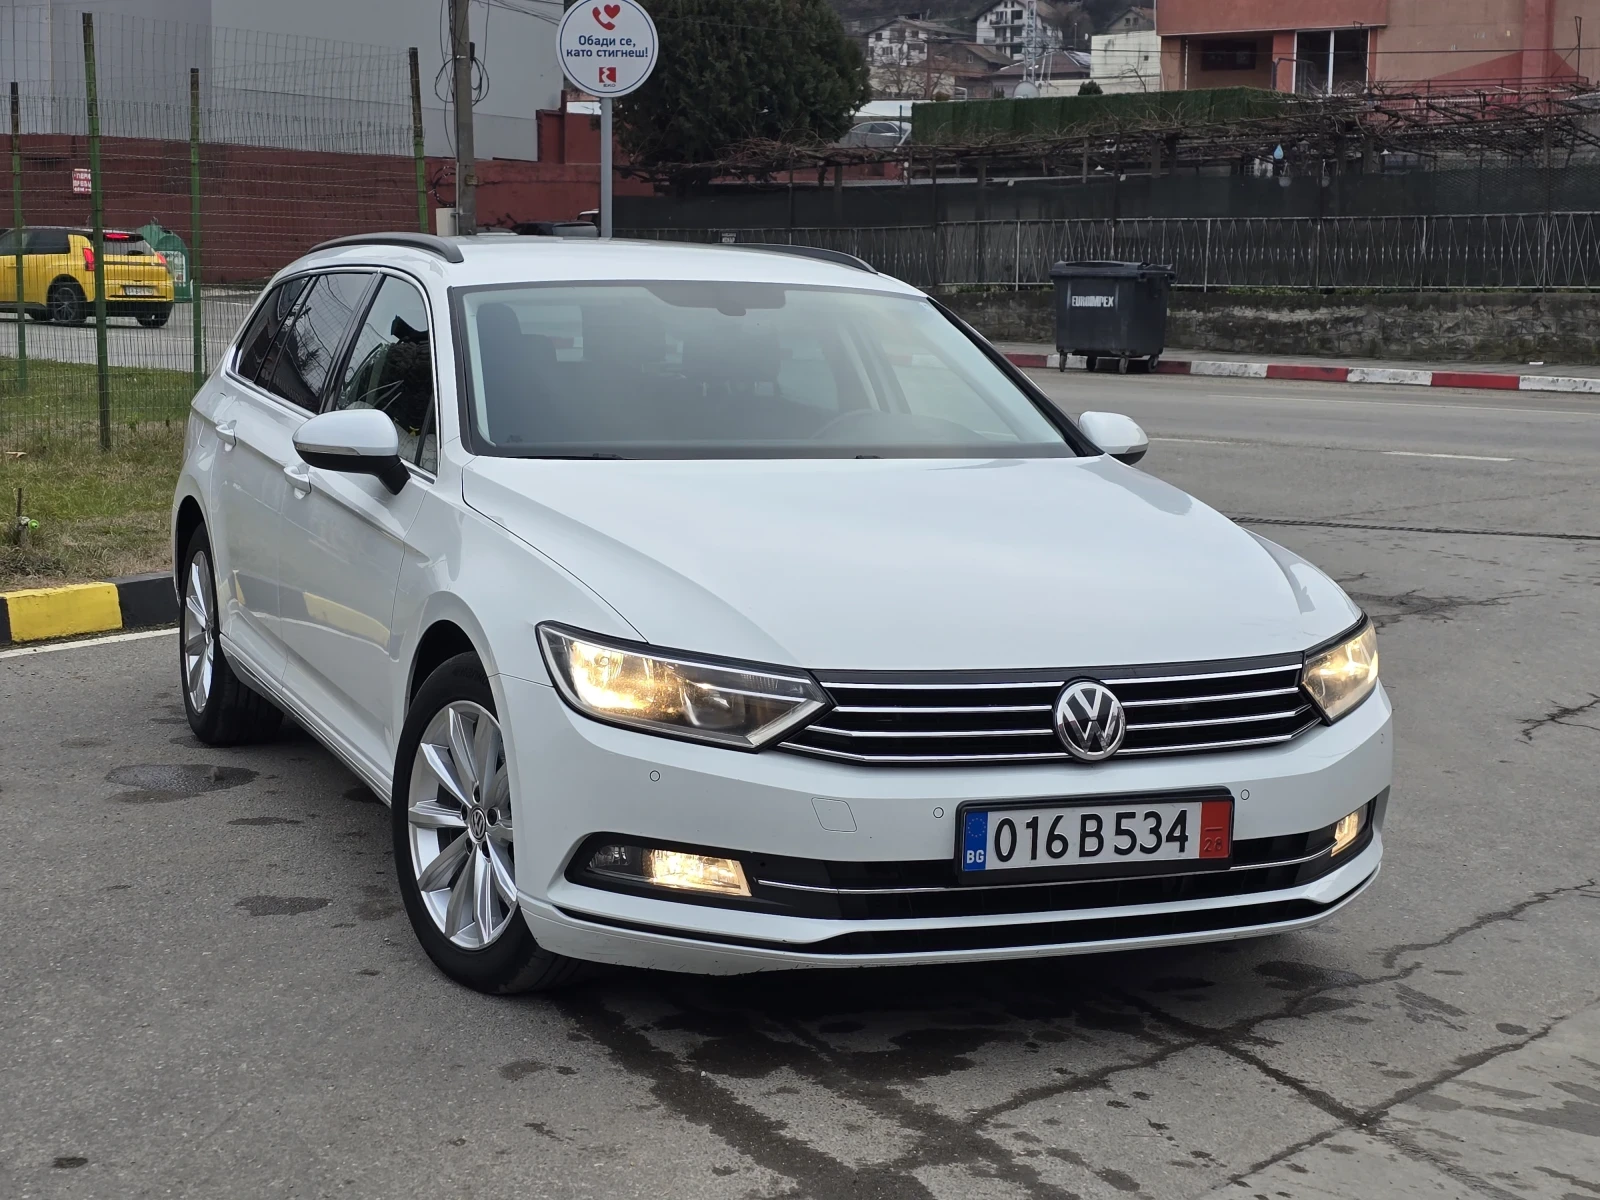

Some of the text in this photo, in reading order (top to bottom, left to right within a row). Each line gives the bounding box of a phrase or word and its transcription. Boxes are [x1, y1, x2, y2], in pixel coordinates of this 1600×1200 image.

[578, 35, 636, 47] Обади се,
[566, 47, 649, 58] като стигнеш!
[1072, 295, 1114, 307] EUROIMPEX
[966, 850, 985, 864] BG
[1203, 836, 1224, 852] 28
